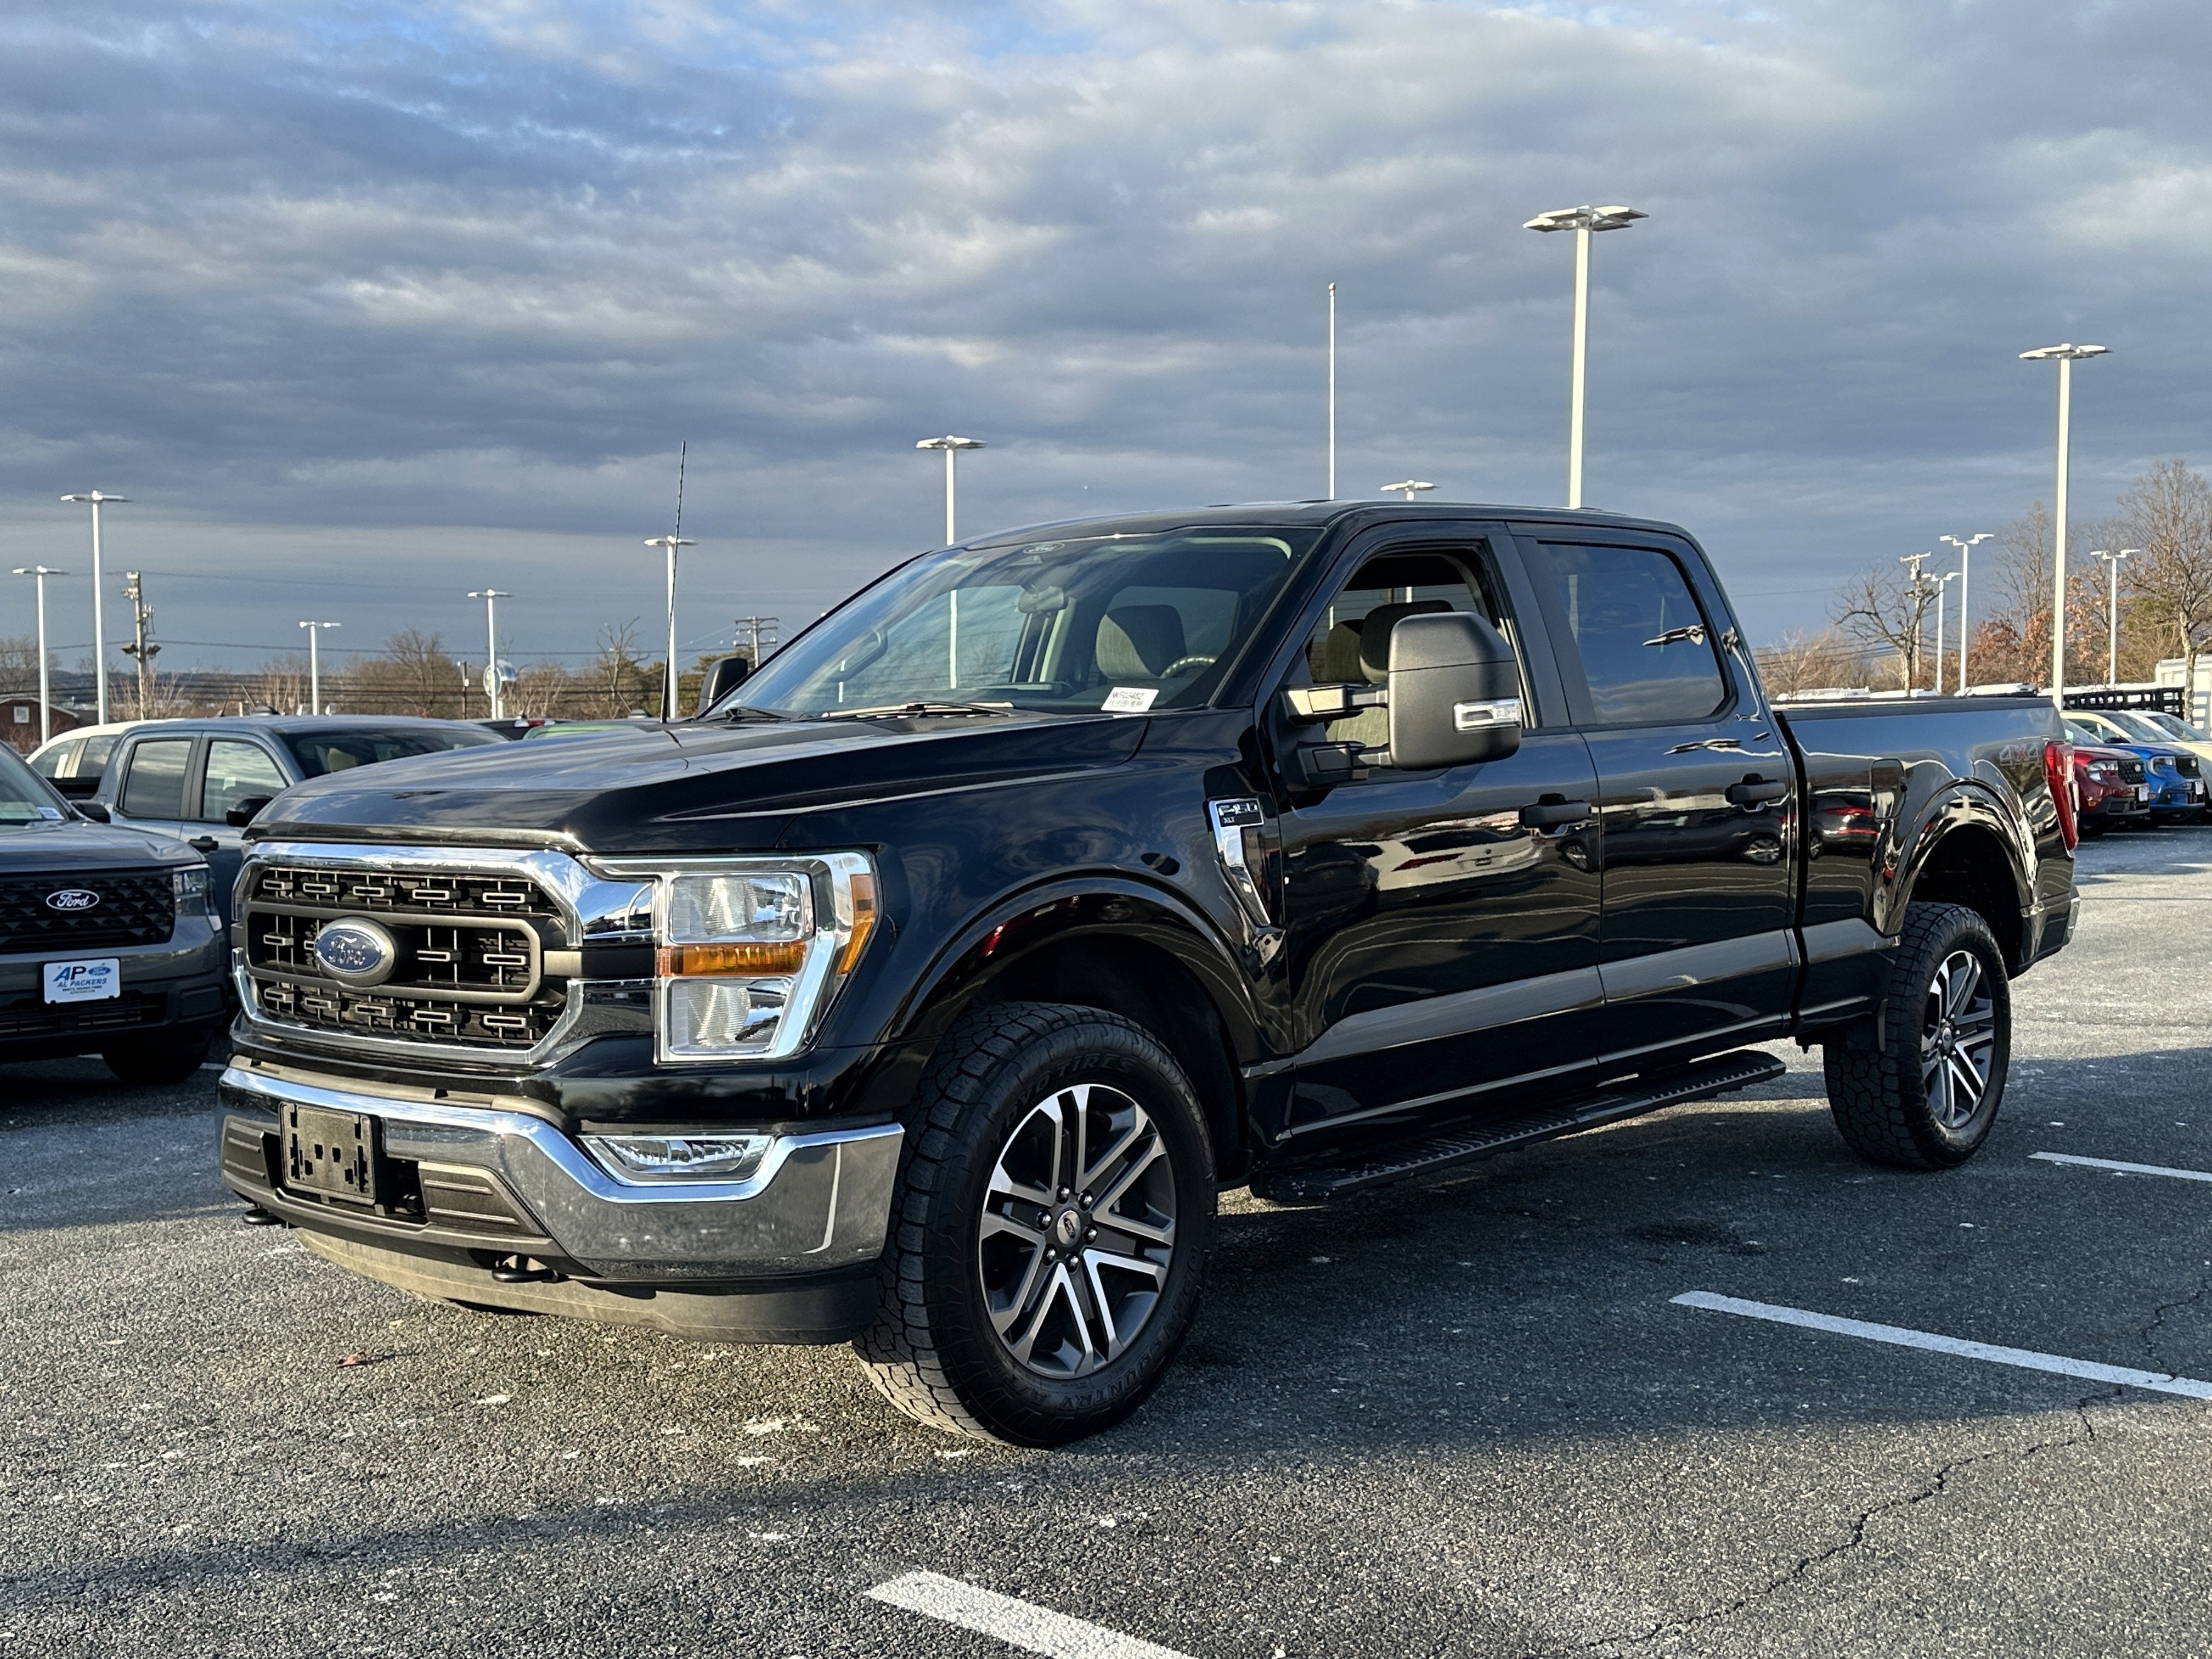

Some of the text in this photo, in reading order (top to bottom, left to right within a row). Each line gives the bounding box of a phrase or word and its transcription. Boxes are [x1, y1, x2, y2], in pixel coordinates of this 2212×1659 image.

[57, 893, 89, 907] Ford
[329, 935, 366, 966] Ford
[53, 966, 87, 982] AP
[1054, 1052, 1139, 1078] TIRES
[1058, 1337, 1167, 1411] COUNTRY
